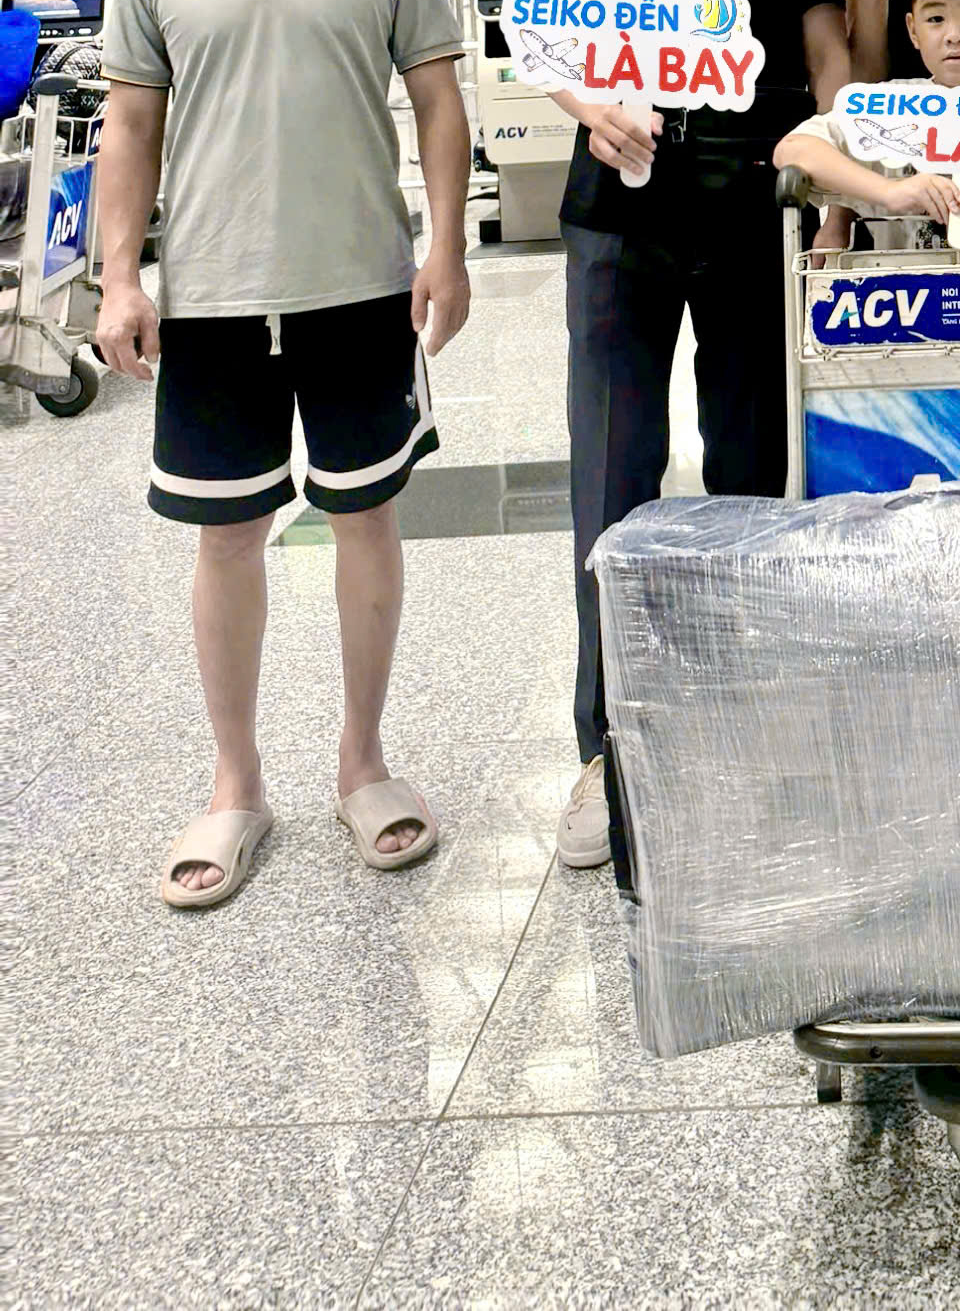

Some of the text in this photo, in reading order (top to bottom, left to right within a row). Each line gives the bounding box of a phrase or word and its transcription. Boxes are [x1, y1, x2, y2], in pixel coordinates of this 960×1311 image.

[583, 30, 755, 96] LÀ BAY
[845, 92, 947, 117] SEIKO
[494, 125, 529, 140] ACV
[48, 200, 83, 250] ACV
[825, 288, 930, 329] ACV
[941, 288, 959, 298] NOI
